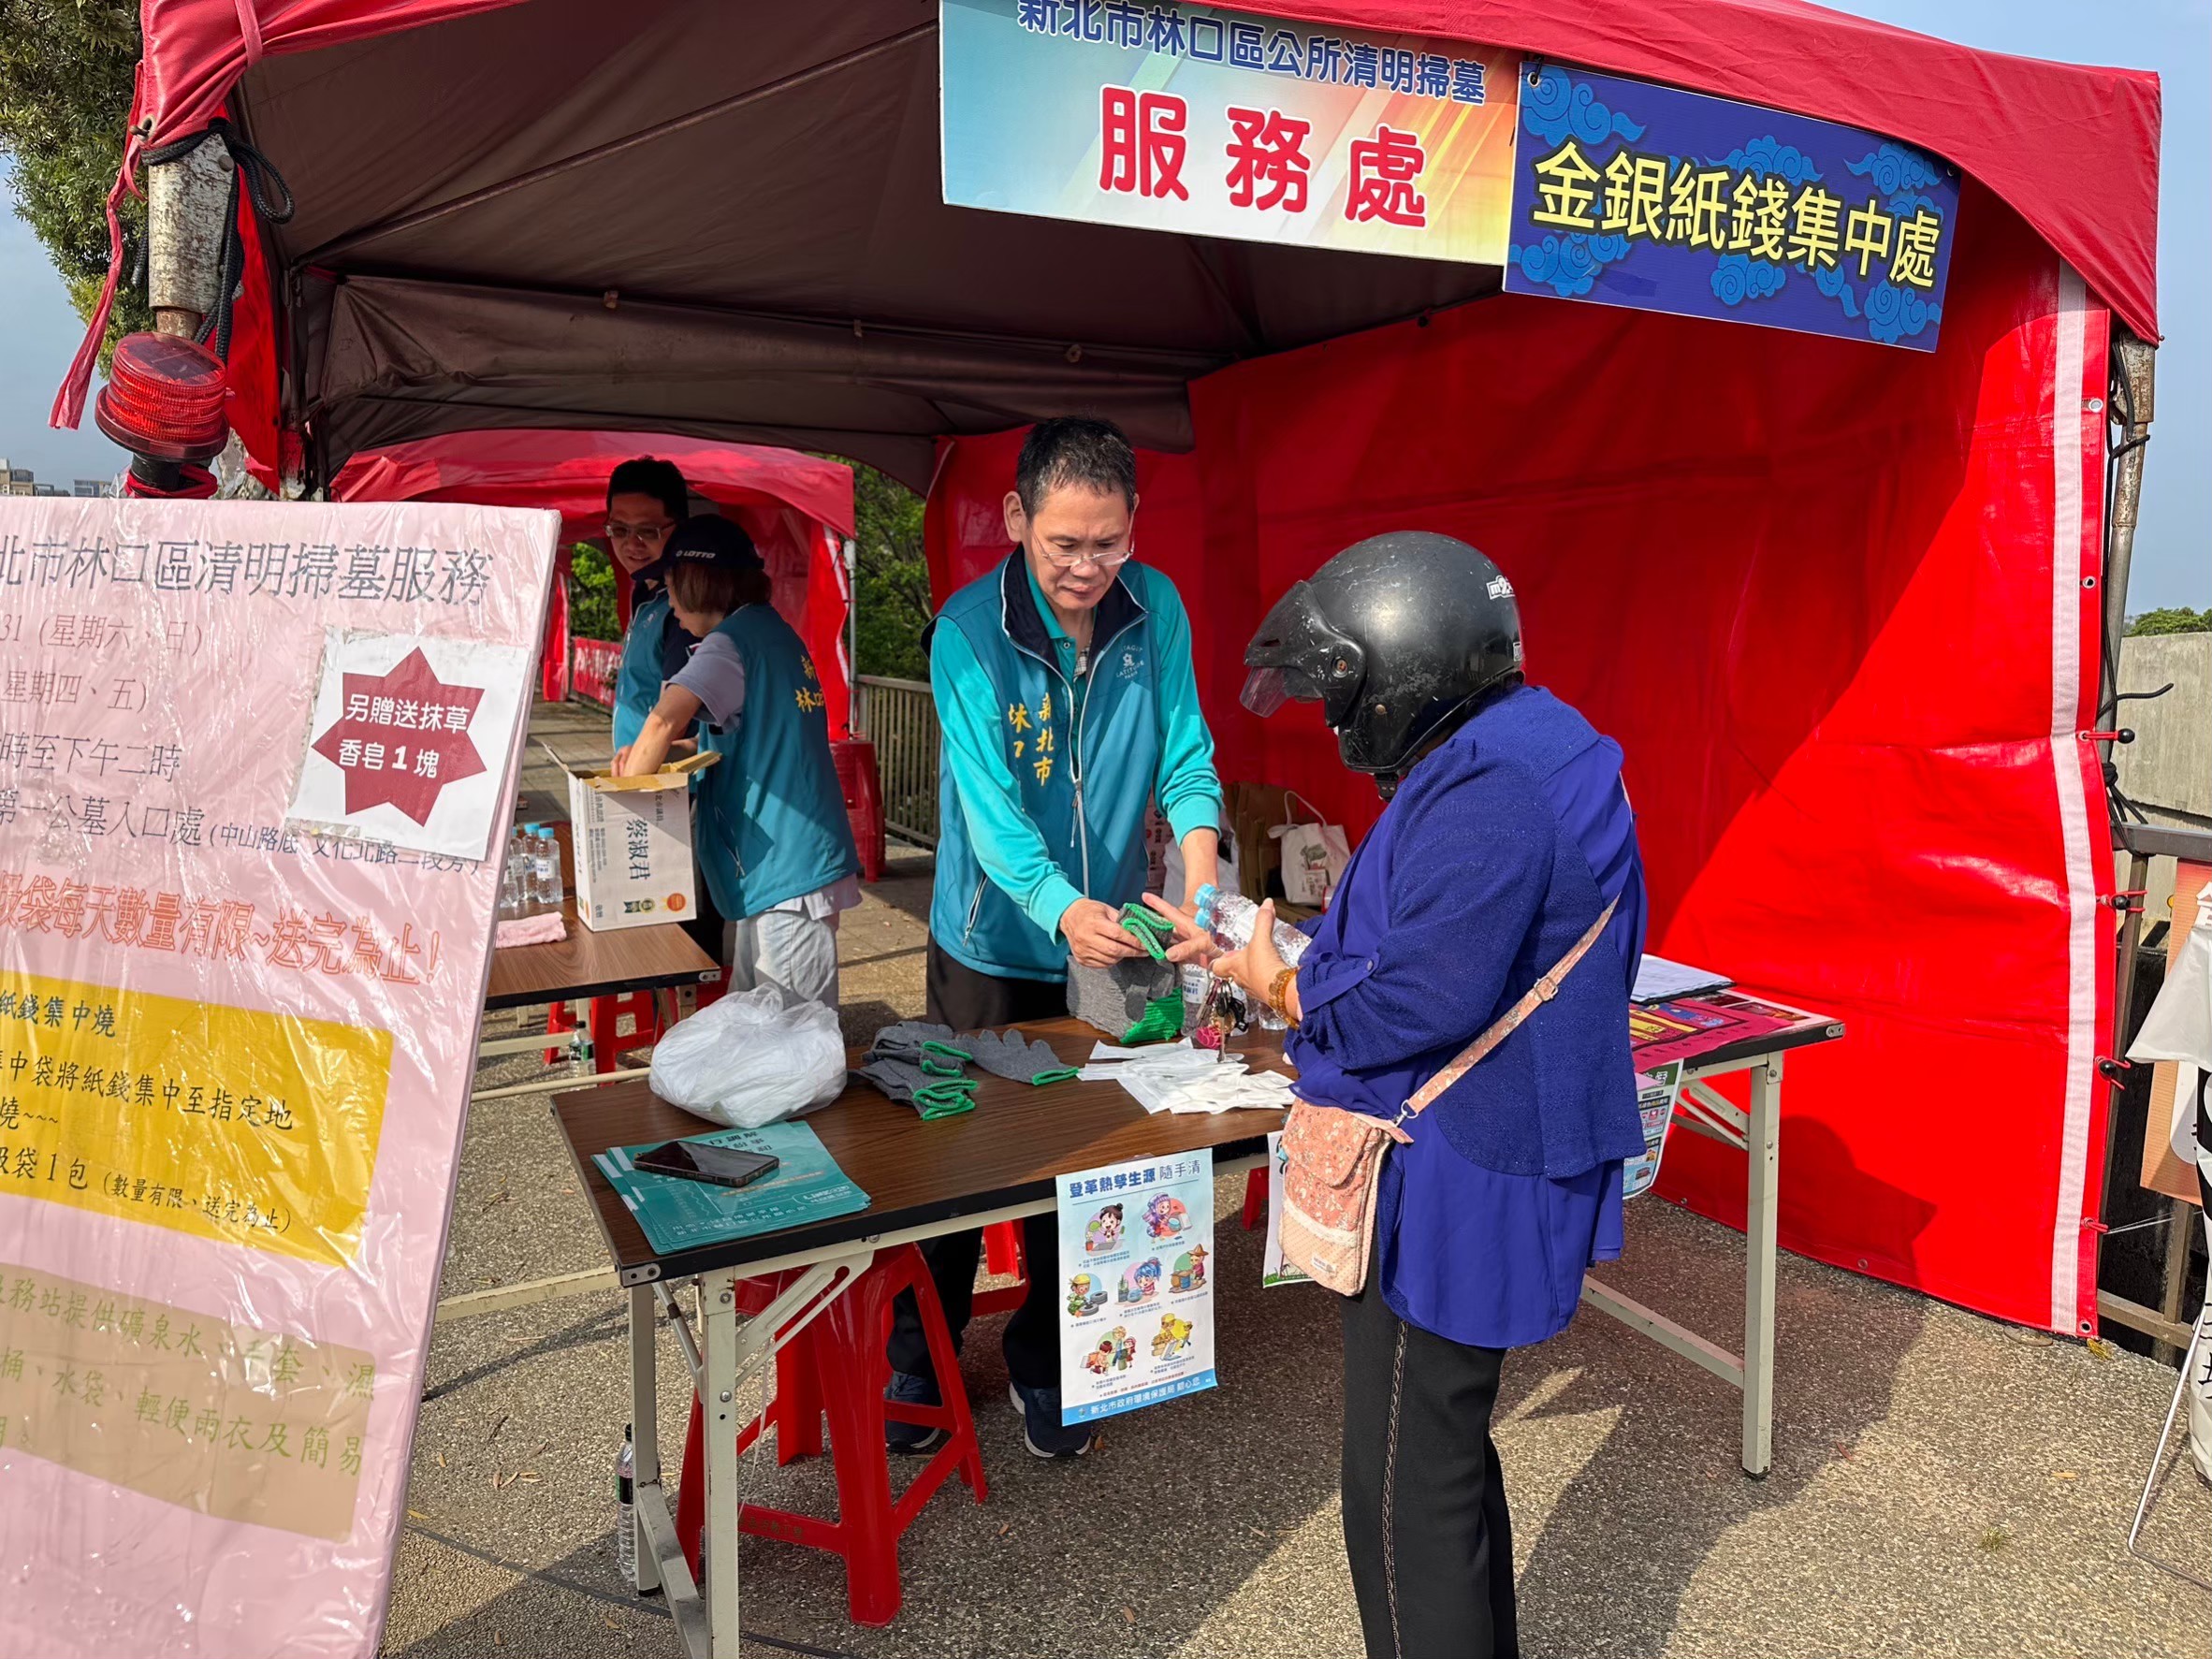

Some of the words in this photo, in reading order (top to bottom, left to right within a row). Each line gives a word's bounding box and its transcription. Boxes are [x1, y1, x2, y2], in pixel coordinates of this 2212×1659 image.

[1019, 0, 1485, 104] 新北市林口區公所清明掃墓
[1099, 86, 1427, 227] 服務處
[1533, 140, 1941, 288] 金銀紙錢集中處
[0, 535, 493, 606] 北市林口區清明掃墓服務
[683, 550, 716, 559] LOTTO
[344, 692, 471, 735] 另贈送抹草
[626, 818, 651, 880] 蔡淑君
[0, 1050, 293, 1131] 中袋將紙錢集中至指定地
[1159, 1159, 1201, 1181] 隨手清
